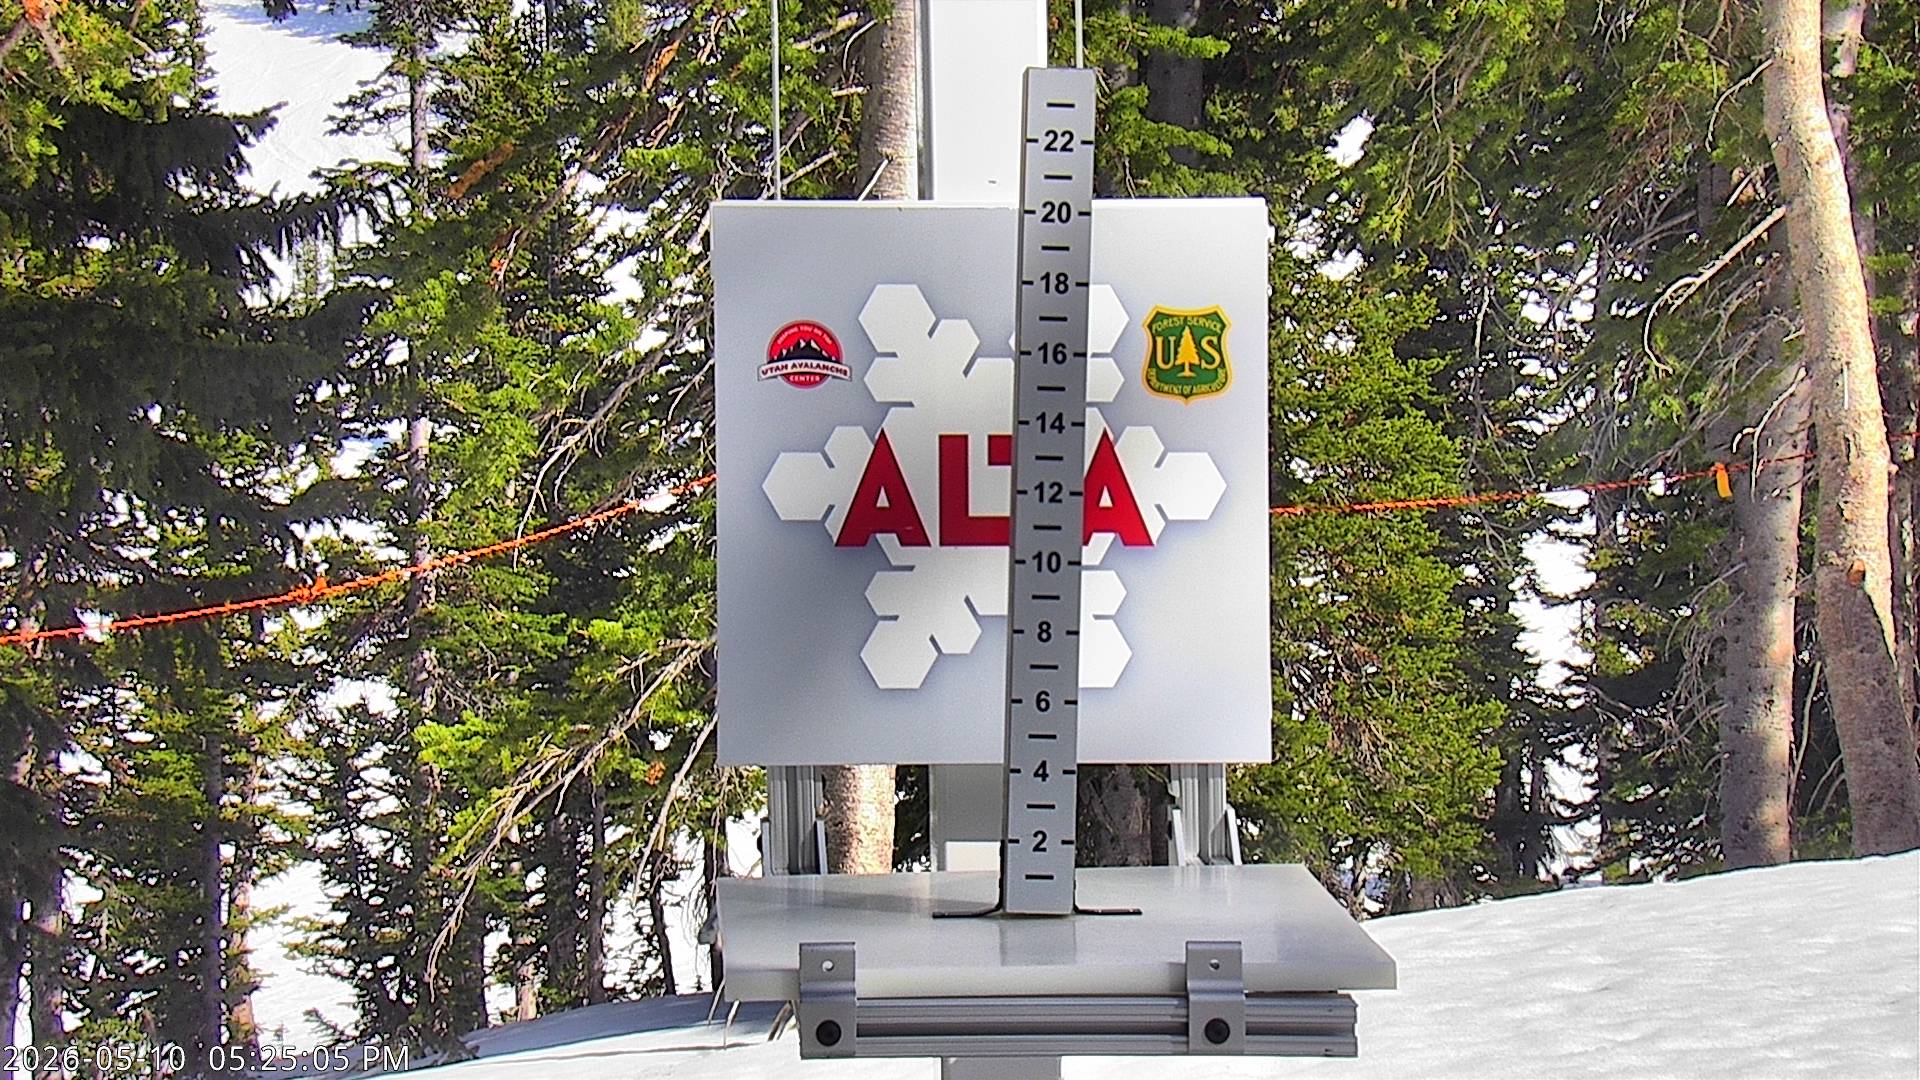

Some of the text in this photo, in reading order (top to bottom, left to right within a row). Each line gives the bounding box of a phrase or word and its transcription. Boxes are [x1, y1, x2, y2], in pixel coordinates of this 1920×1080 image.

[1043, 129, 1074, 153] 22
[1040, 201, 1072, 224] 20
[1039, 271, 1069, 295] 18
[1152, 316, 1222, 334] FOREST SERVICE
[1037, 341, 1068, 366] 16
[761, 362, 848, 376] UTAH AVALANCHE
[1035, 411, 1066, 435] 14
[1033, 480, 1064, 505] 12
[1031, 550, 1062, 574] 10
[1036, 620, 1052, 644] 8
[1035, 690, 1051, 713] 6
[1032, 759, 1050, 783] 4
[1032, 830, 1048, 853] 2
